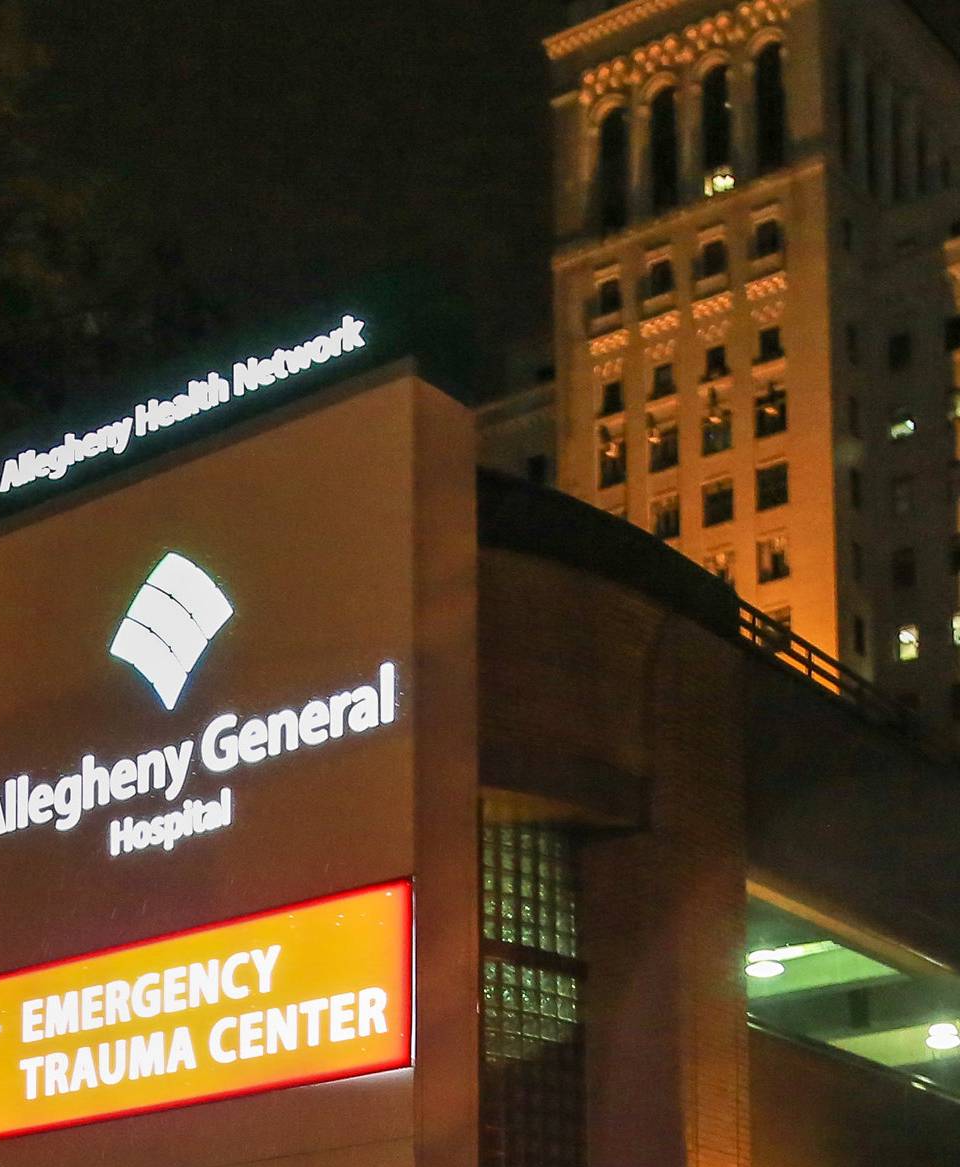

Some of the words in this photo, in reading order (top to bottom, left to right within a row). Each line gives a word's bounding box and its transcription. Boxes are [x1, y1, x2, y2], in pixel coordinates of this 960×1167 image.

[0, 417, 134, 493] Allegheny
[135, 371, 230, 437] Health
[233, 315, 366, 396] Network
[200, 661, 396, 773] General
[109, 787, 232, 857] Hospital
[19, 1026, 197, 1101] TRAUMA
[208, 987, 388, 1064] CENTER
[20, 944, 282, 1044] EMERGENCY
